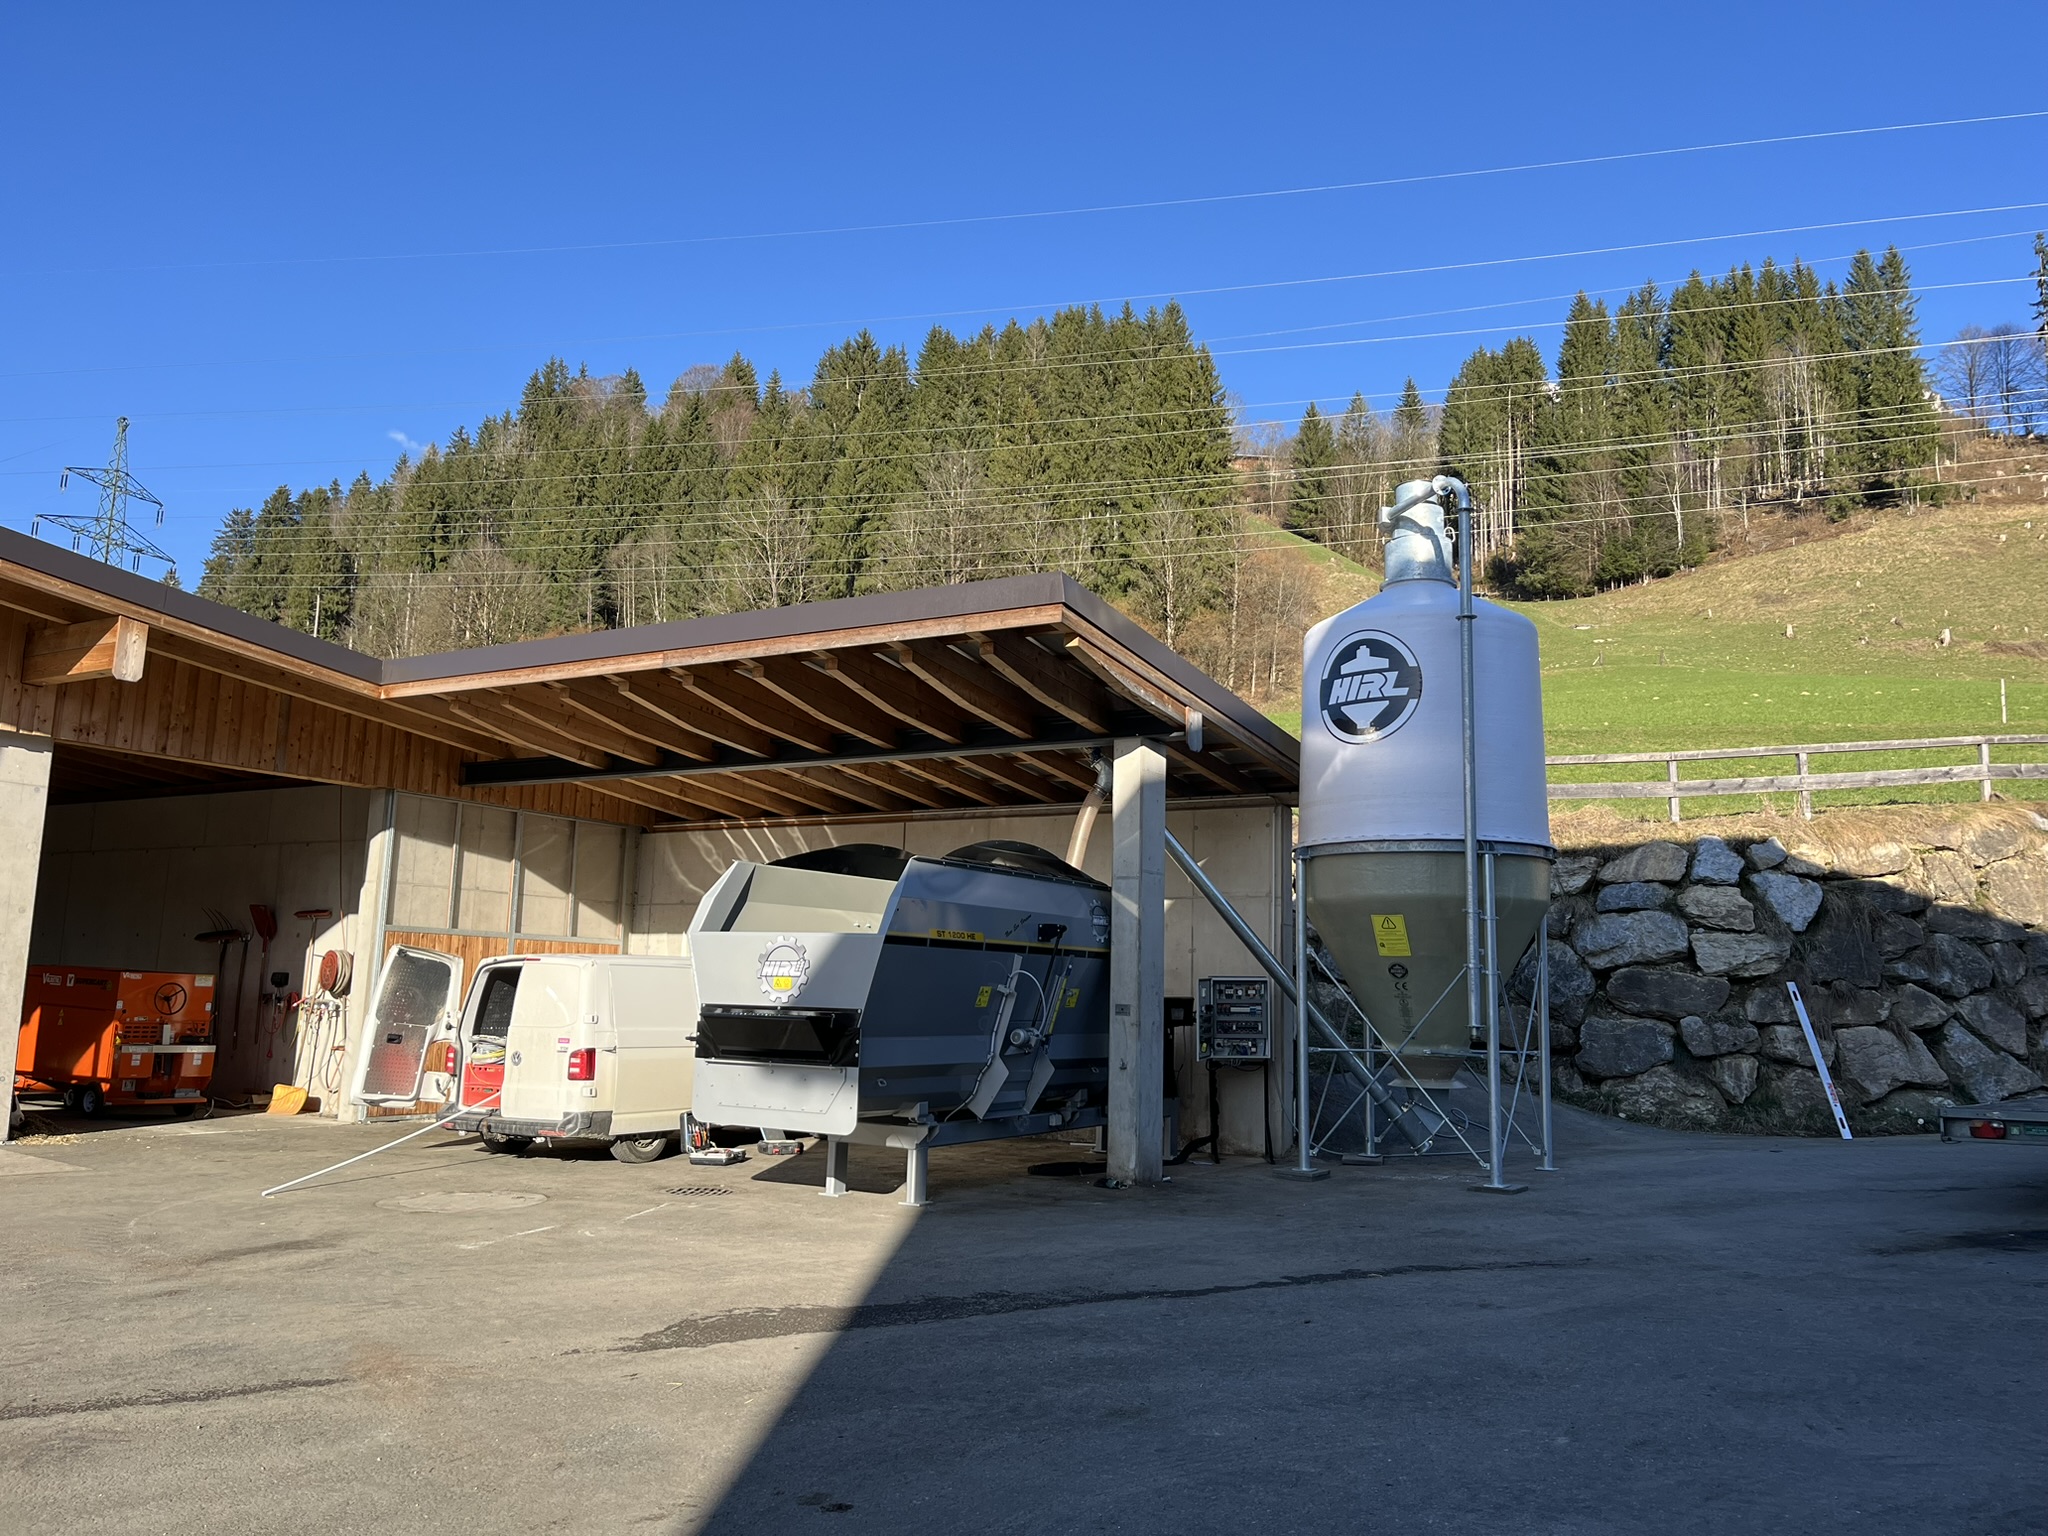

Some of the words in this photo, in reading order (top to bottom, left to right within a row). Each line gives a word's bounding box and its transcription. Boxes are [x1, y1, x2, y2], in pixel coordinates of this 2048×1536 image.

[1328, 671, 1410, 706] HIRL
[936, 930, 945, 938] ST
[948, 931, 966, 939] 1200
[761, 960, 803, 977] HIRL
